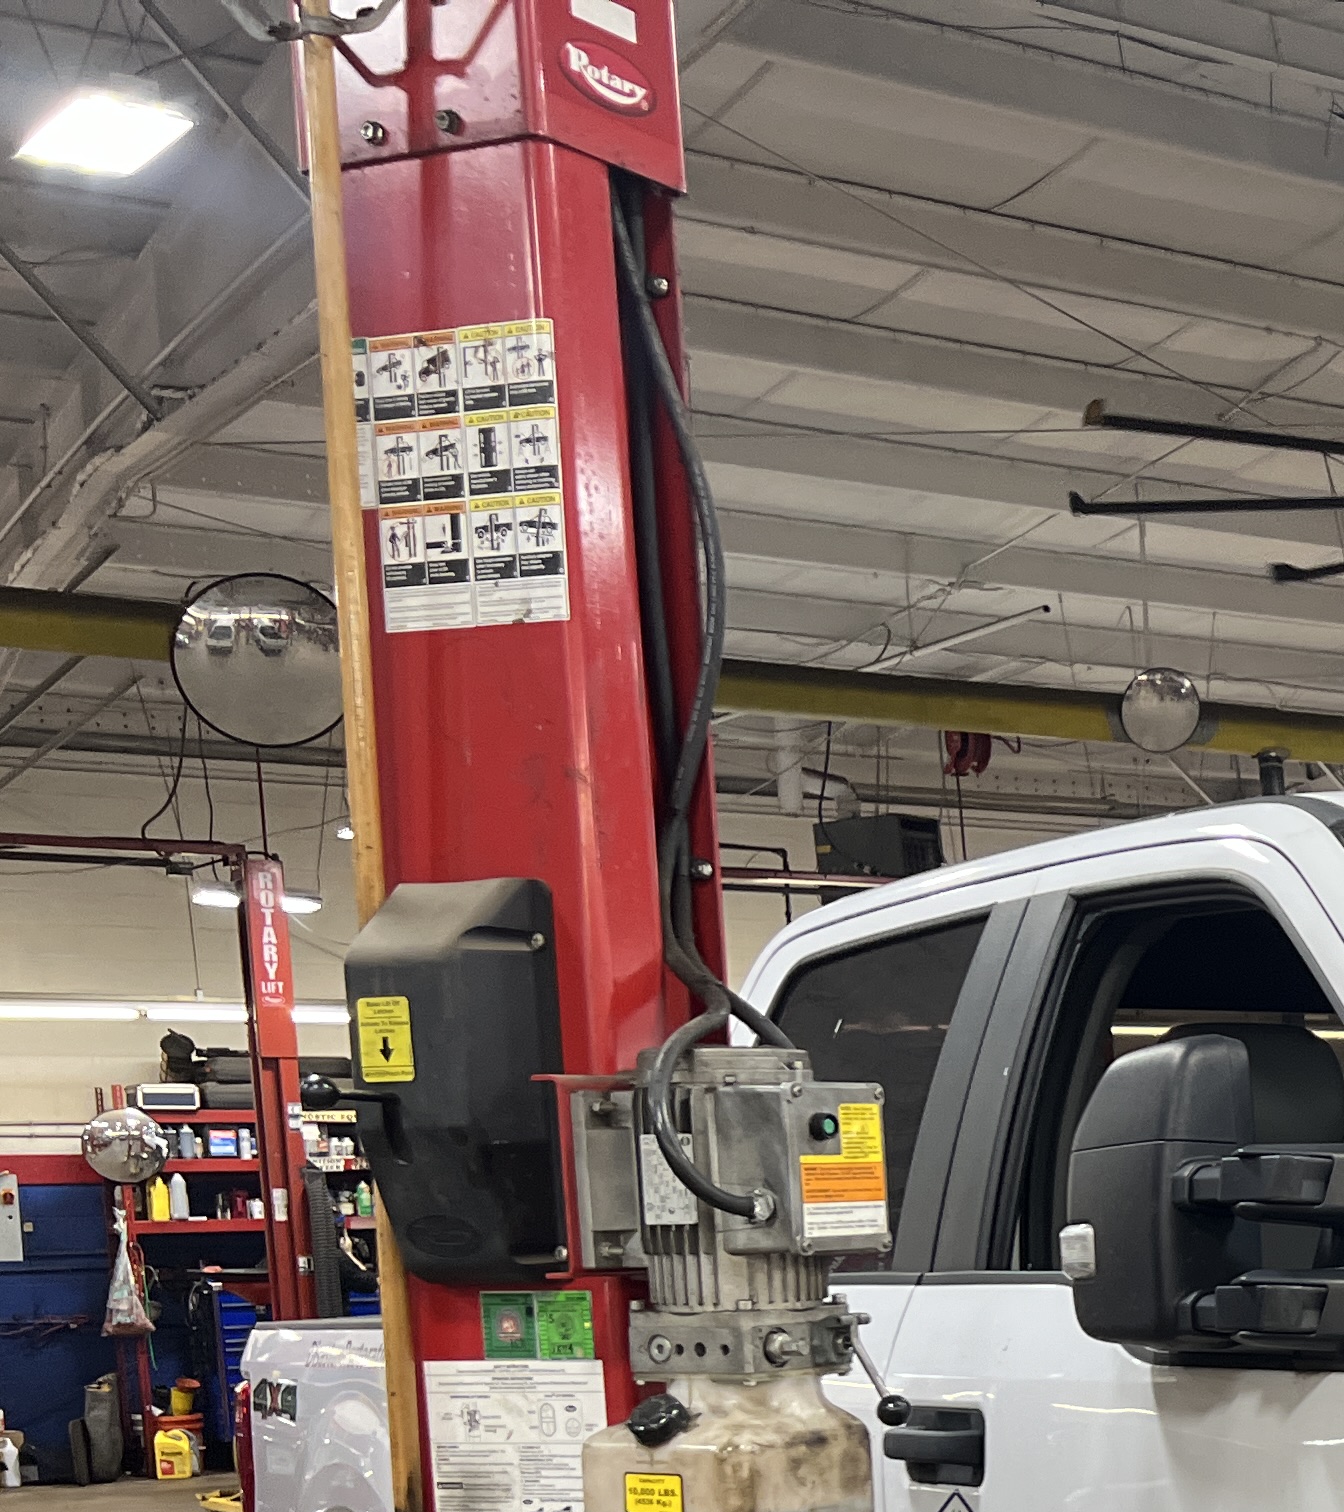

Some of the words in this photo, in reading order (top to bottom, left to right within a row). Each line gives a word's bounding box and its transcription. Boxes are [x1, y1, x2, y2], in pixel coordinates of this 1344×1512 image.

[565, 42, 648, 105] Rotary
[481, 499, 510, 509] CAUTION
[526, 494, 556, 505] CAUTION
[258, 871, 280, 980] ROTARY
[261, 981, 284, 994] LIFT
